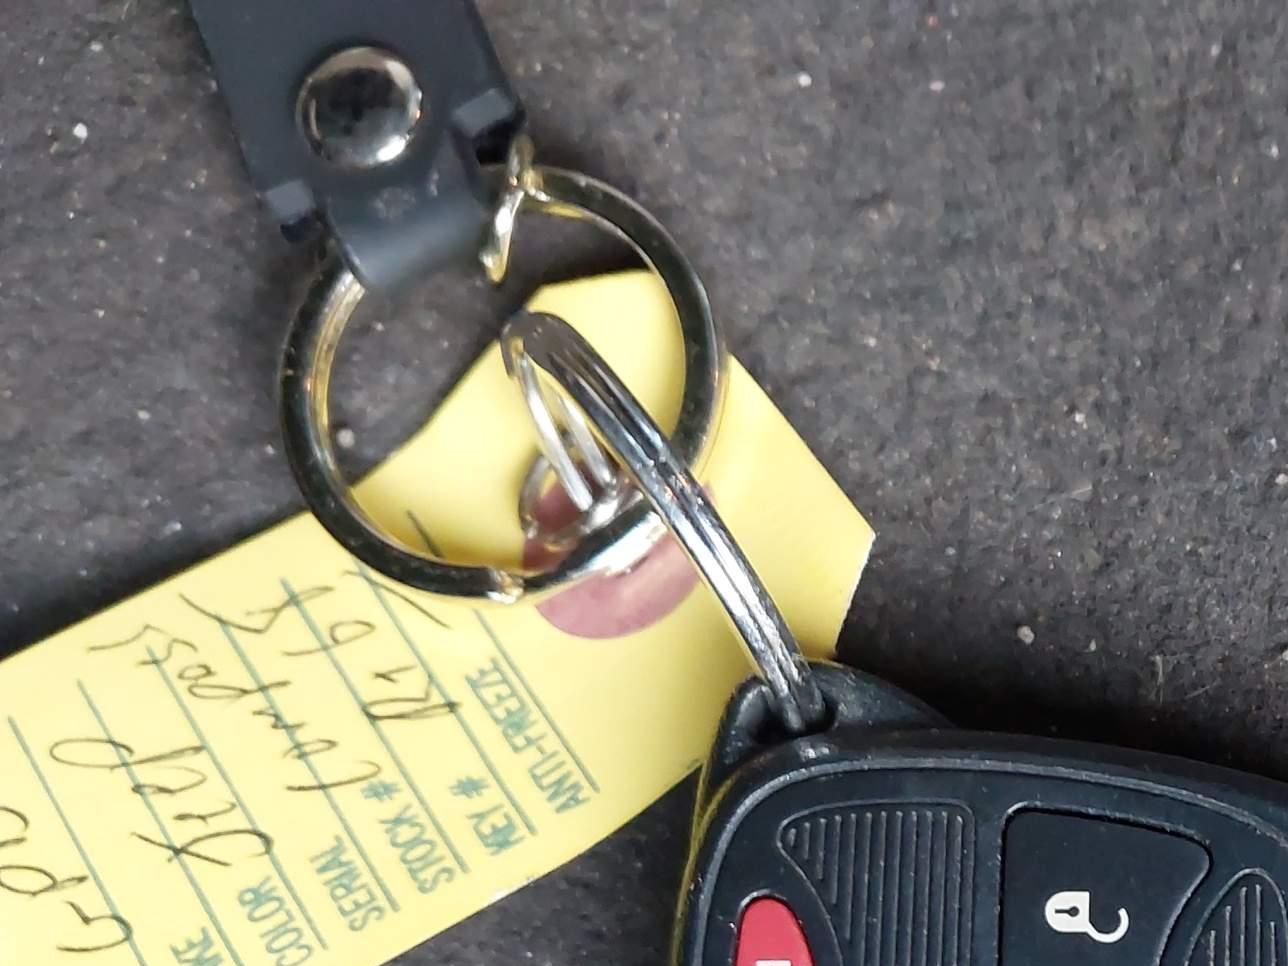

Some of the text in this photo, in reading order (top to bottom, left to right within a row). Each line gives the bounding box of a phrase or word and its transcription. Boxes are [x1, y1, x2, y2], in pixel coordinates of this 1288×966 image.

[464, 657, 595, 815] ANTI-FREEZE
[361, 776, 457, 896] STOCK #
[449, 774, 527, 857] KEY #
[309, 834, 385, 932] SERIAL
